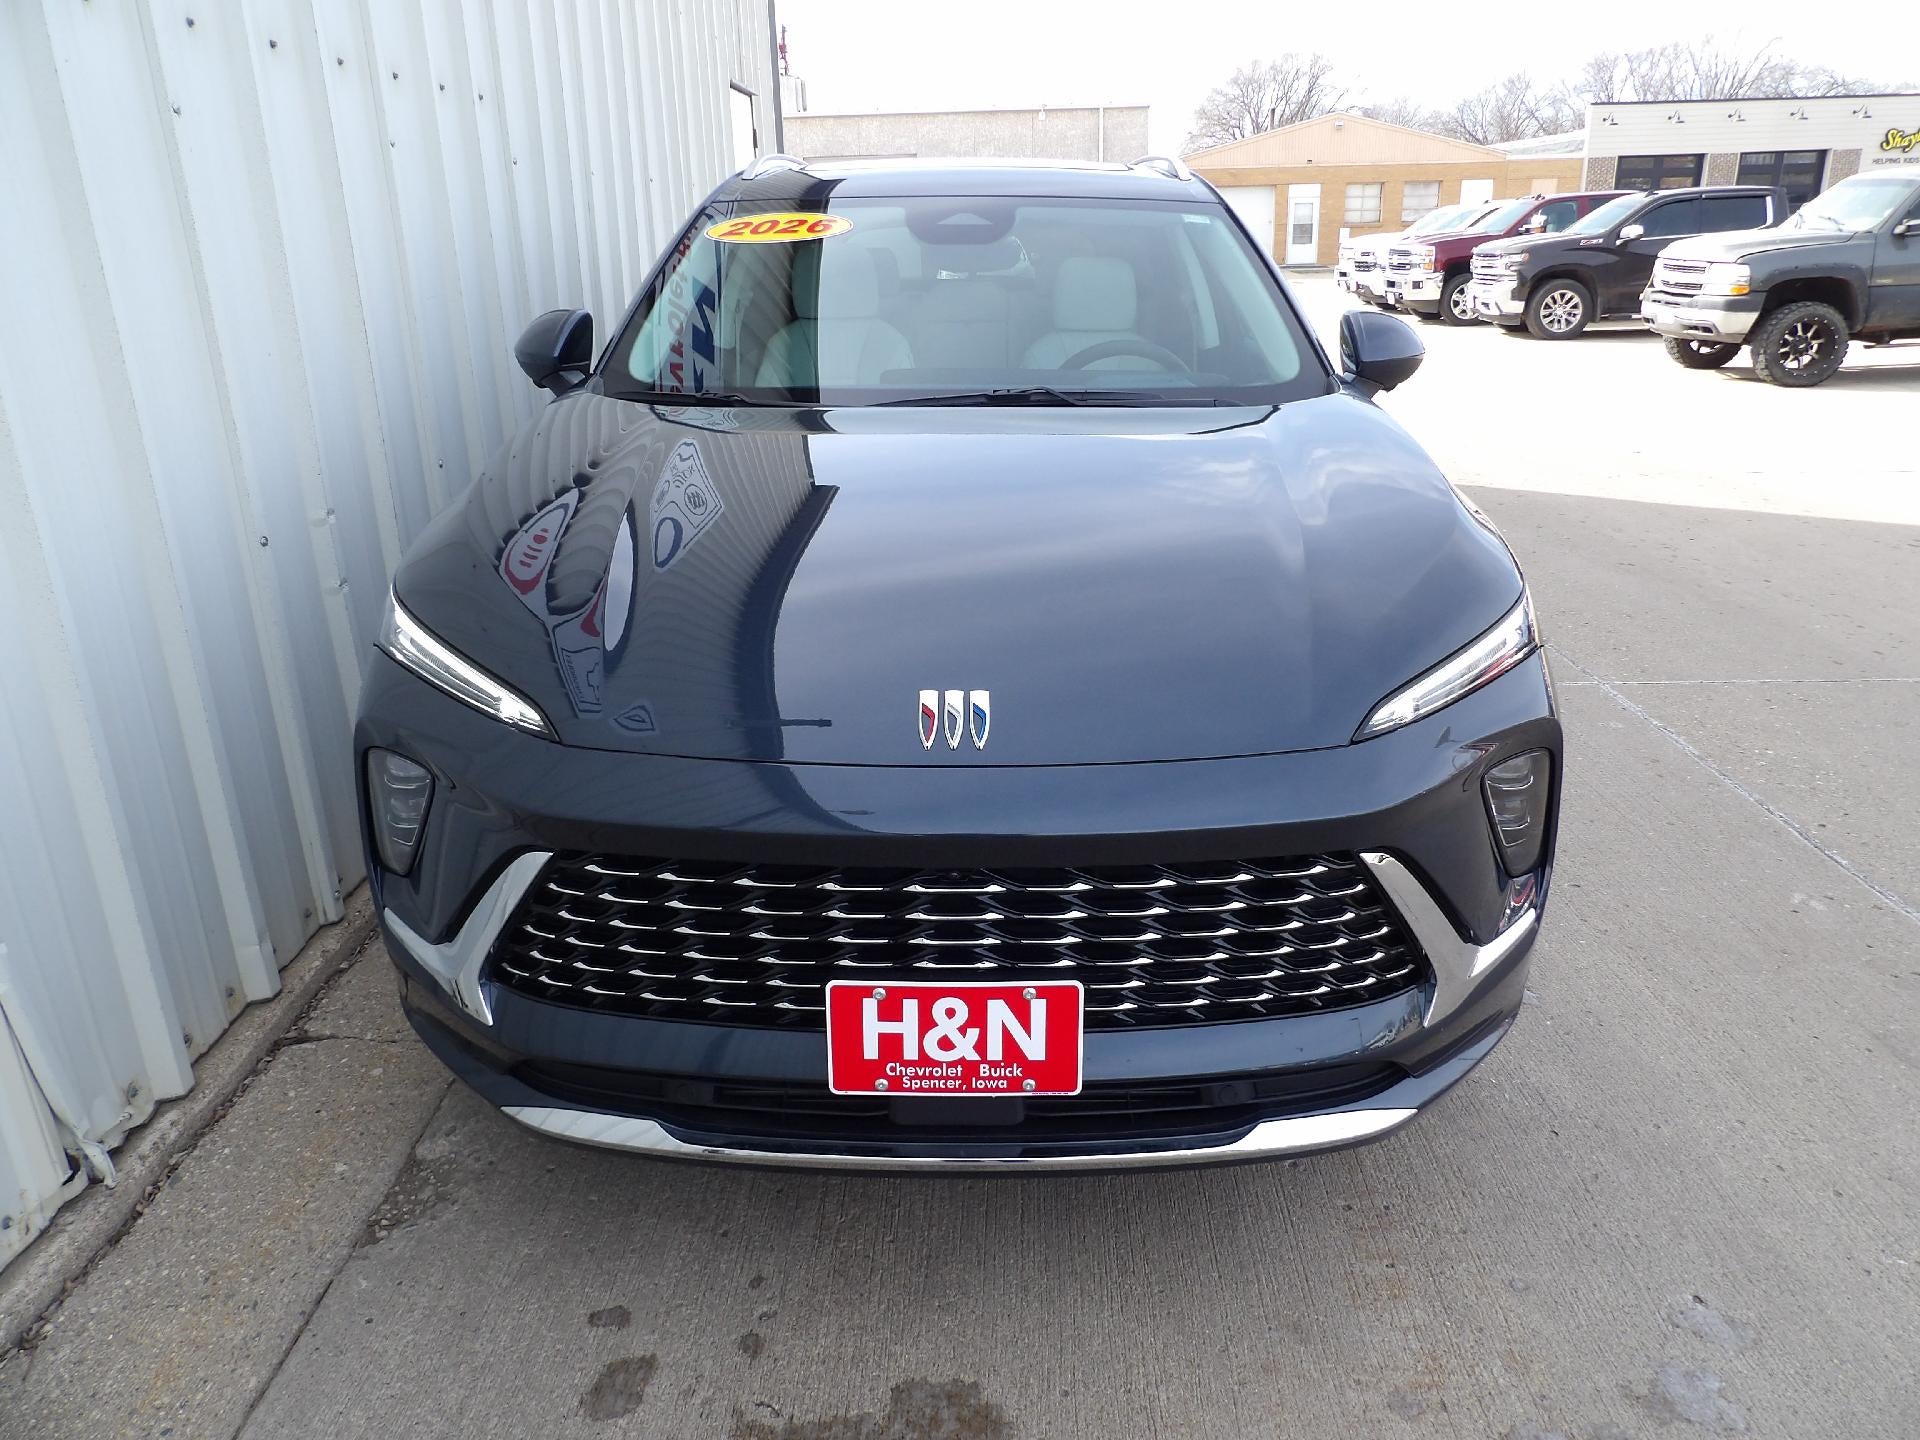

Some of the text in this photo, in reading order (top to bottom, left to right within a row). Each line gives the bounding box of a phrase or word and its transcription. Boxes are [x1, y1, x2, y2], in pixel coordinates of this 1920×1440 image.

[1880, 128, 1920, 153] Shay
[719, 219, 838, 237] 2026
[862, 997, 1047, 1061] H&N
[885, 1062, 1023, 1077] Chevrolet Buick
[902, 1076, 1007, 1091] Spencer, Iowa
